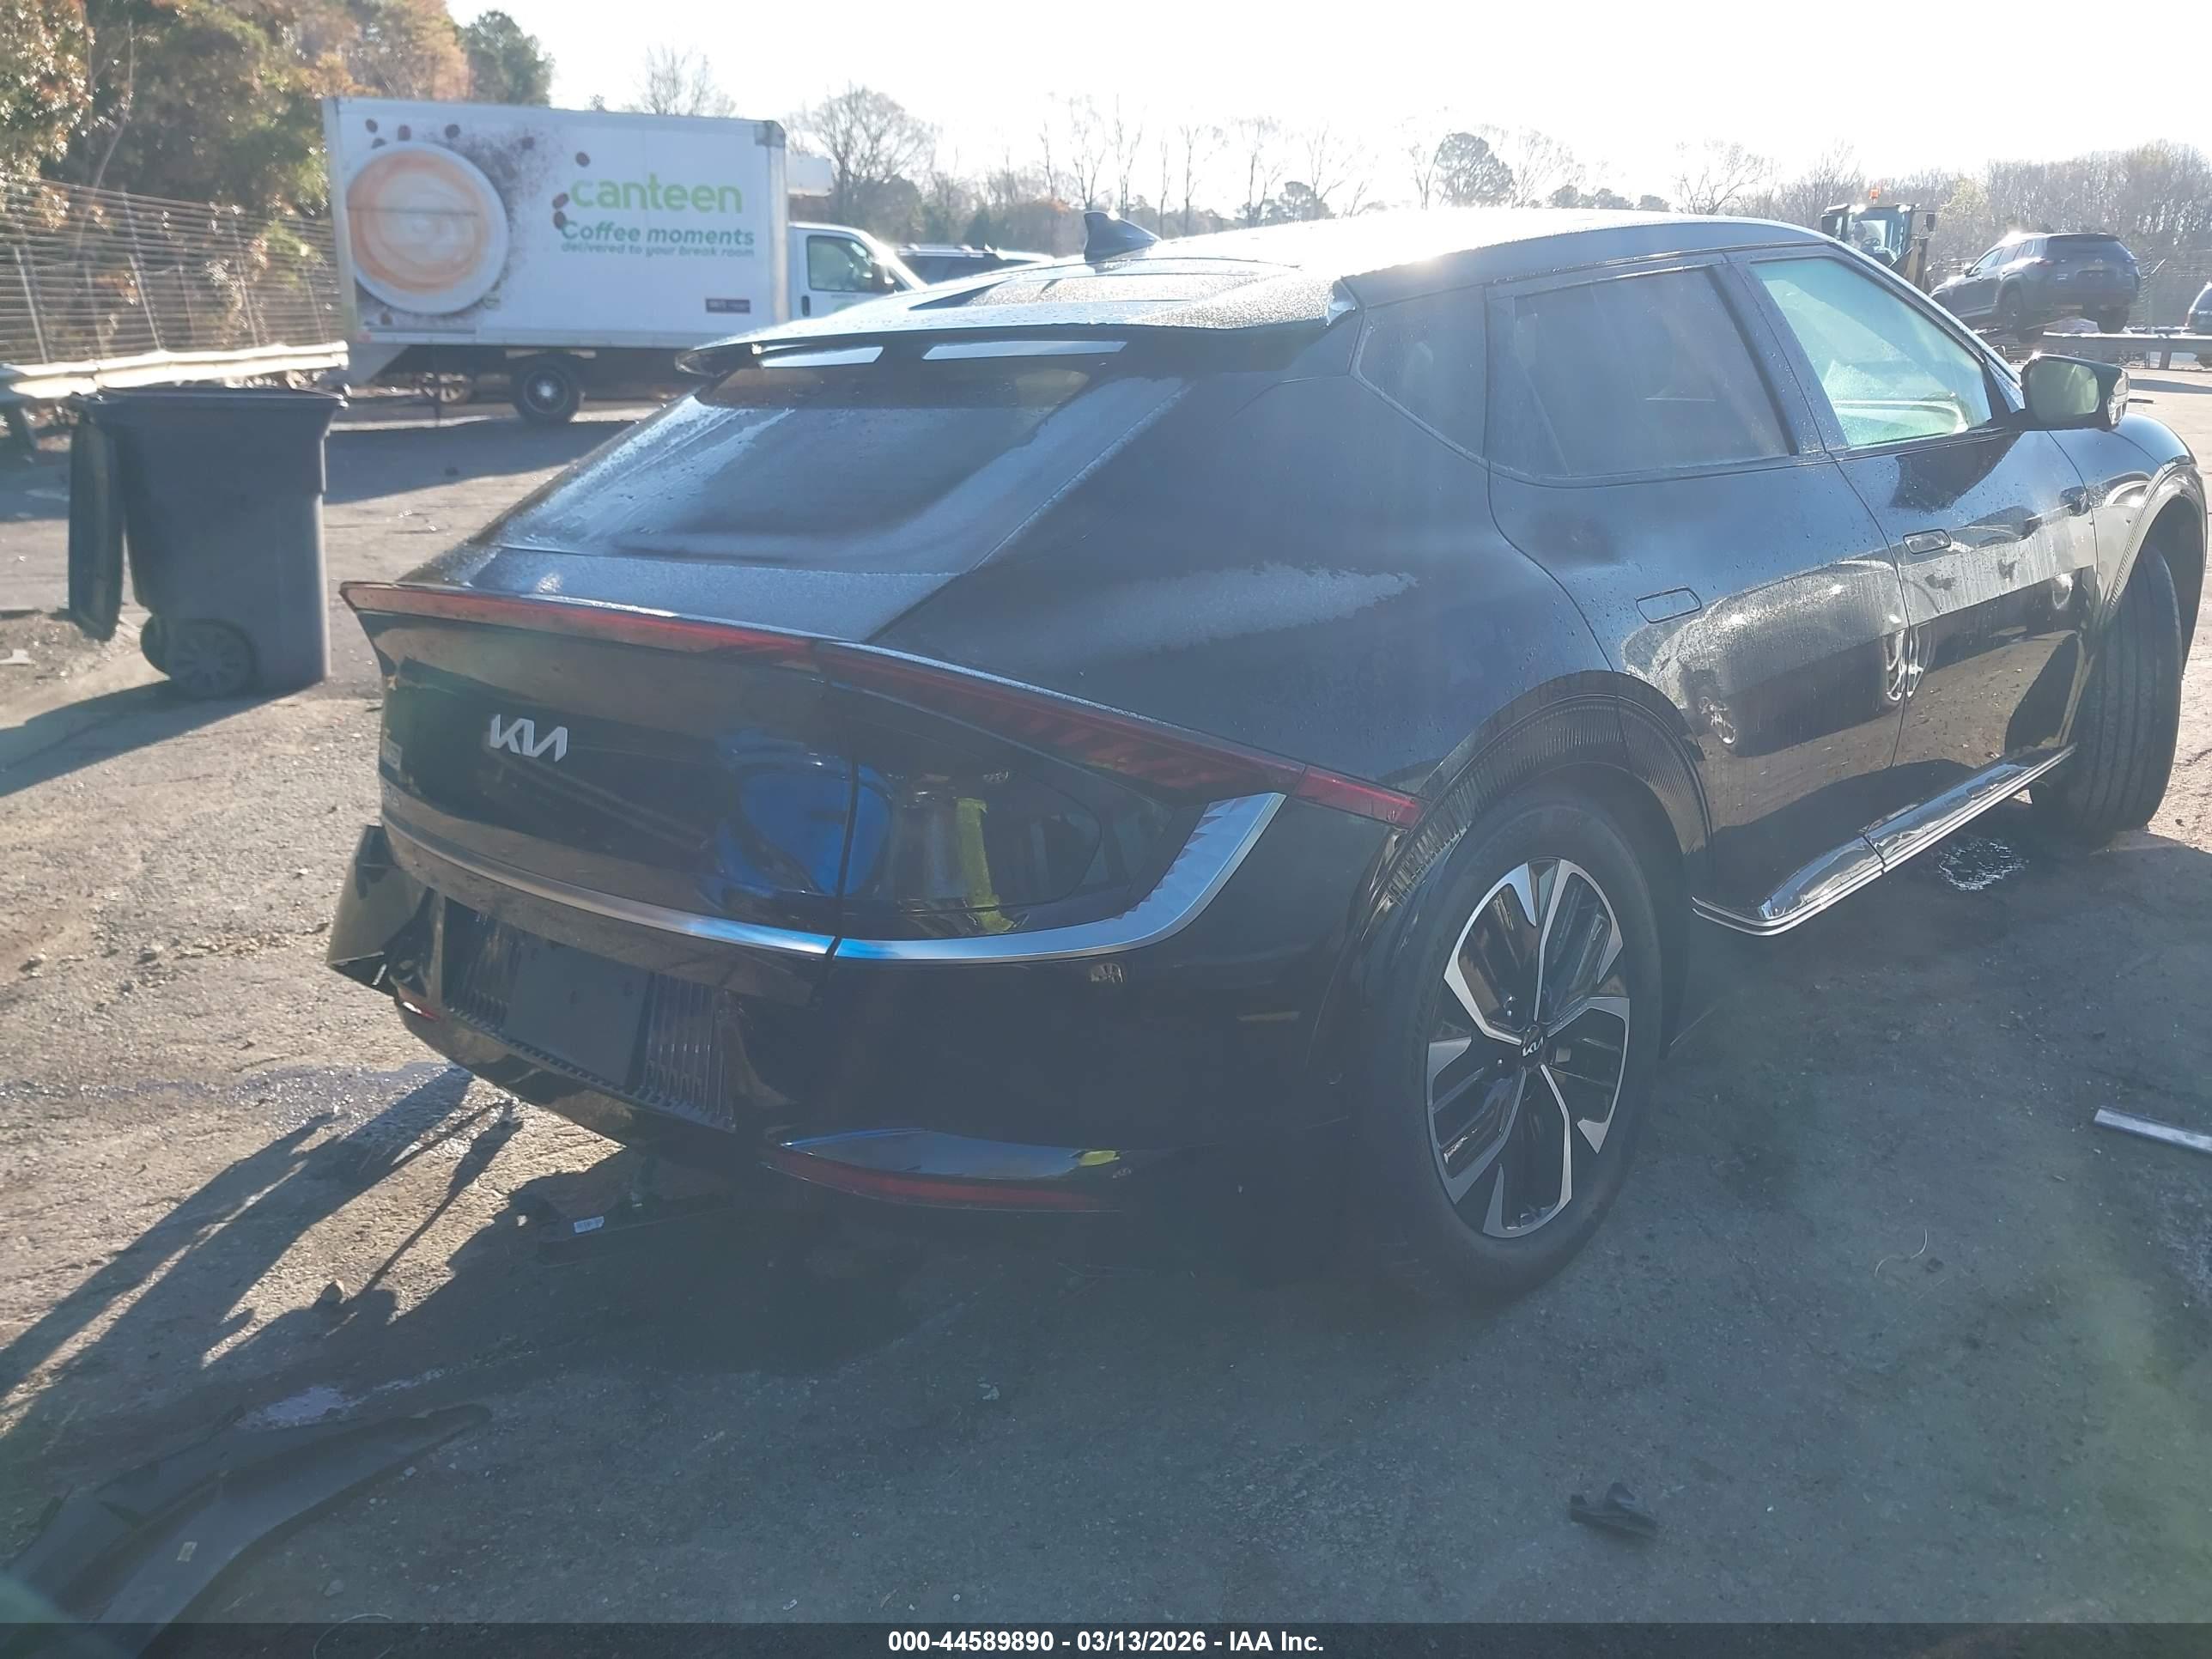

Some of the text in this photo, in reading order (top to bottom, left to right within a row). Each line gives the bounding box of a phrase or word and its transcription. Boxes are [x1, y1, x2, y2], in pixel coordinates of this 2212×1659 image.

[571, 172, 742, 214] canteen
[561, 241, 755, 258] delivered to your break room
[562, 220, 755, 246] Coffee moments
[489, 714, 568, 763] KIA
